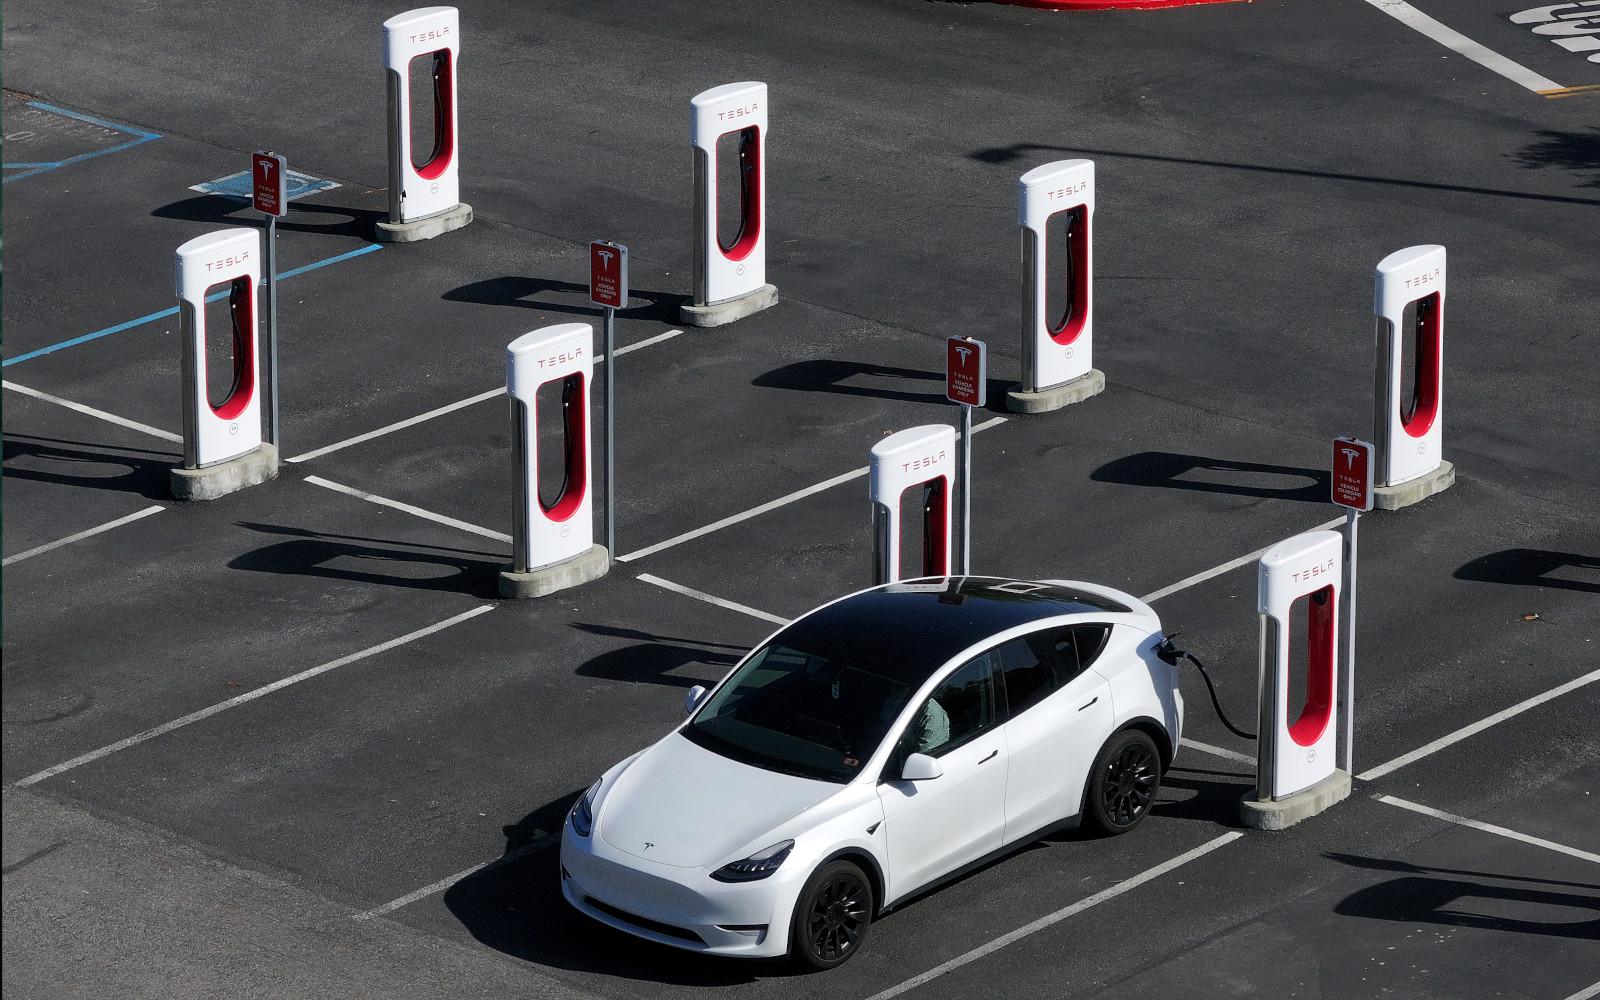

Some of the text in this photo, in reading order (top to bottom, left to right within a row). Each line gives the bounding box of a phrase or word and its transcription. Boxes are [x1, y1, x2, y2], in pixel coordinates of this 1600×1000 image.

[409, 26, 449, 44] TESLA
[718, 103, 758, 121] TESLA
[1047, 181, 1087, 200] TESLA
[205, 251, 249, 272] TESLA
[597, 275, 615, 283] TESLA
[1405, 267, 1440, 289] TESLA
[595, 287, 617, 297] CHARGING
[598, 283, 615, 291] VEHICLE
[538, 347, 582, 369] TESLA
[954, 372, 974, 380] TESLA
[952, 384, 975, 394] CHARGING
[955, 380, 972, 388] VEHICLE
[957, 390, 969, 398] ONLY
[901, 450, 946, 473] TESLA
[1339, 474, 1361, 484] TESLA
[1337, 487, 1361, 497] CHARGING
[1340, 483, 1359, 492] VEHICLE
[1292, 558, 1334, 585] TESLA
